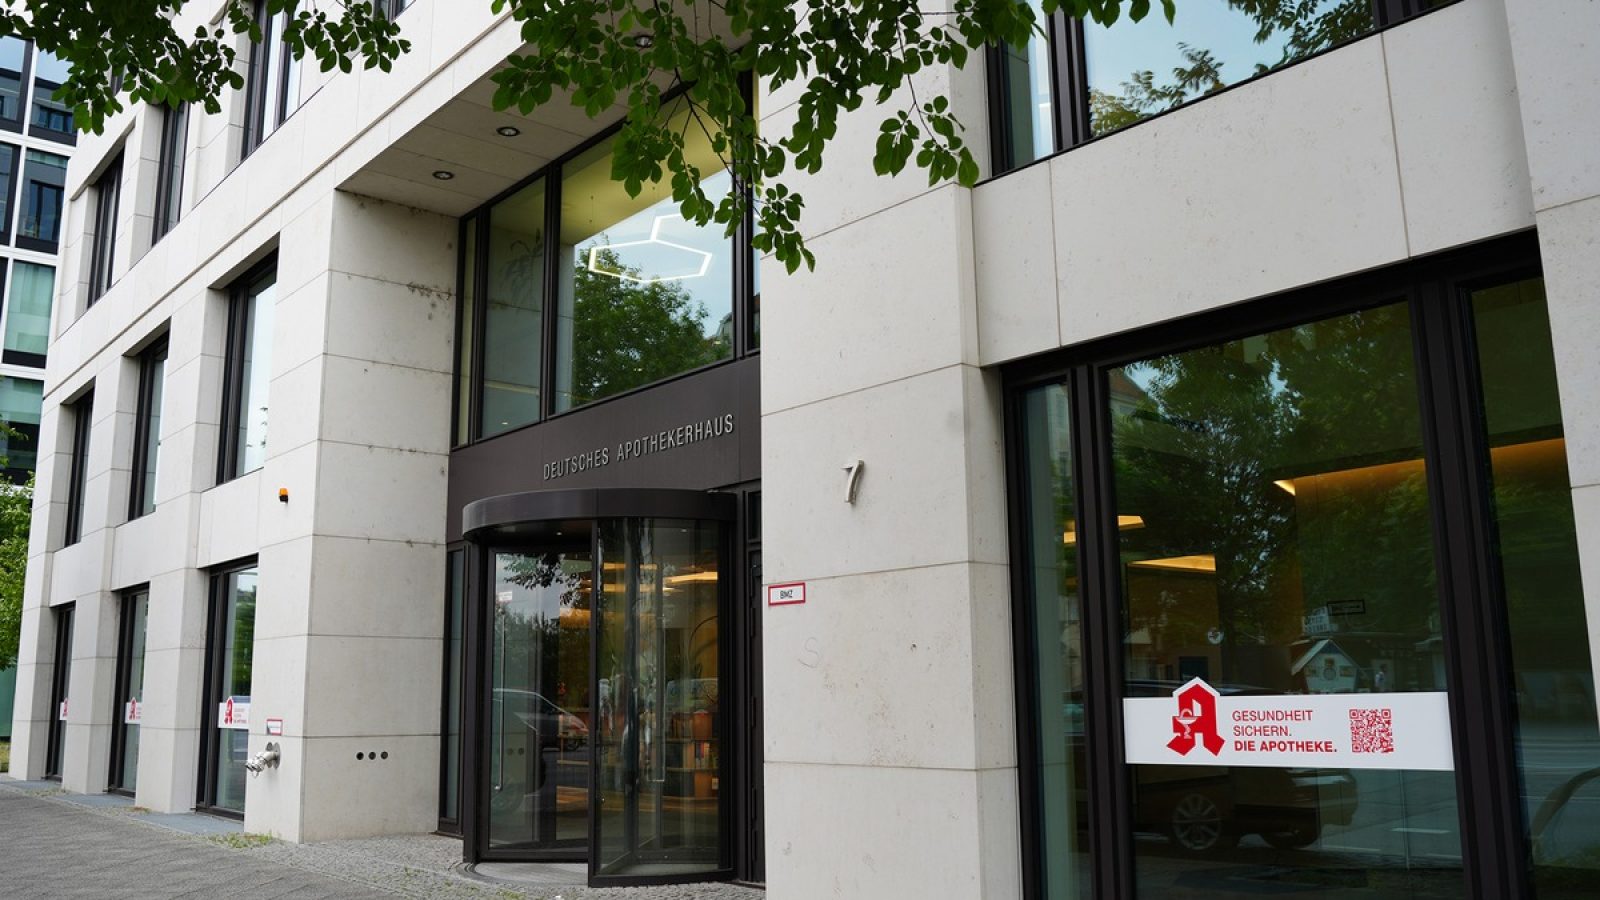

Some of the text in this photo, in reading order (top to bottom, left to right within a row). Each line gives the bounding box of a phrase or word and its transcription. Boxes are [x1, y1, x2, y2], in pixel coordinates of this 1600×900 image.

[543, 413, 734, 481] DEUTSCHES APOTHEKERHAUS
[841, 459, 865, 505] 7
[779, 590, 793, 600] BMZ
[1232, 709, 1313, 722] GESUNDHEIT
[1233, 724, 1293, 738] SICHERN.
[1234, 740, 1338, 753] DIE APOTHEKE.
